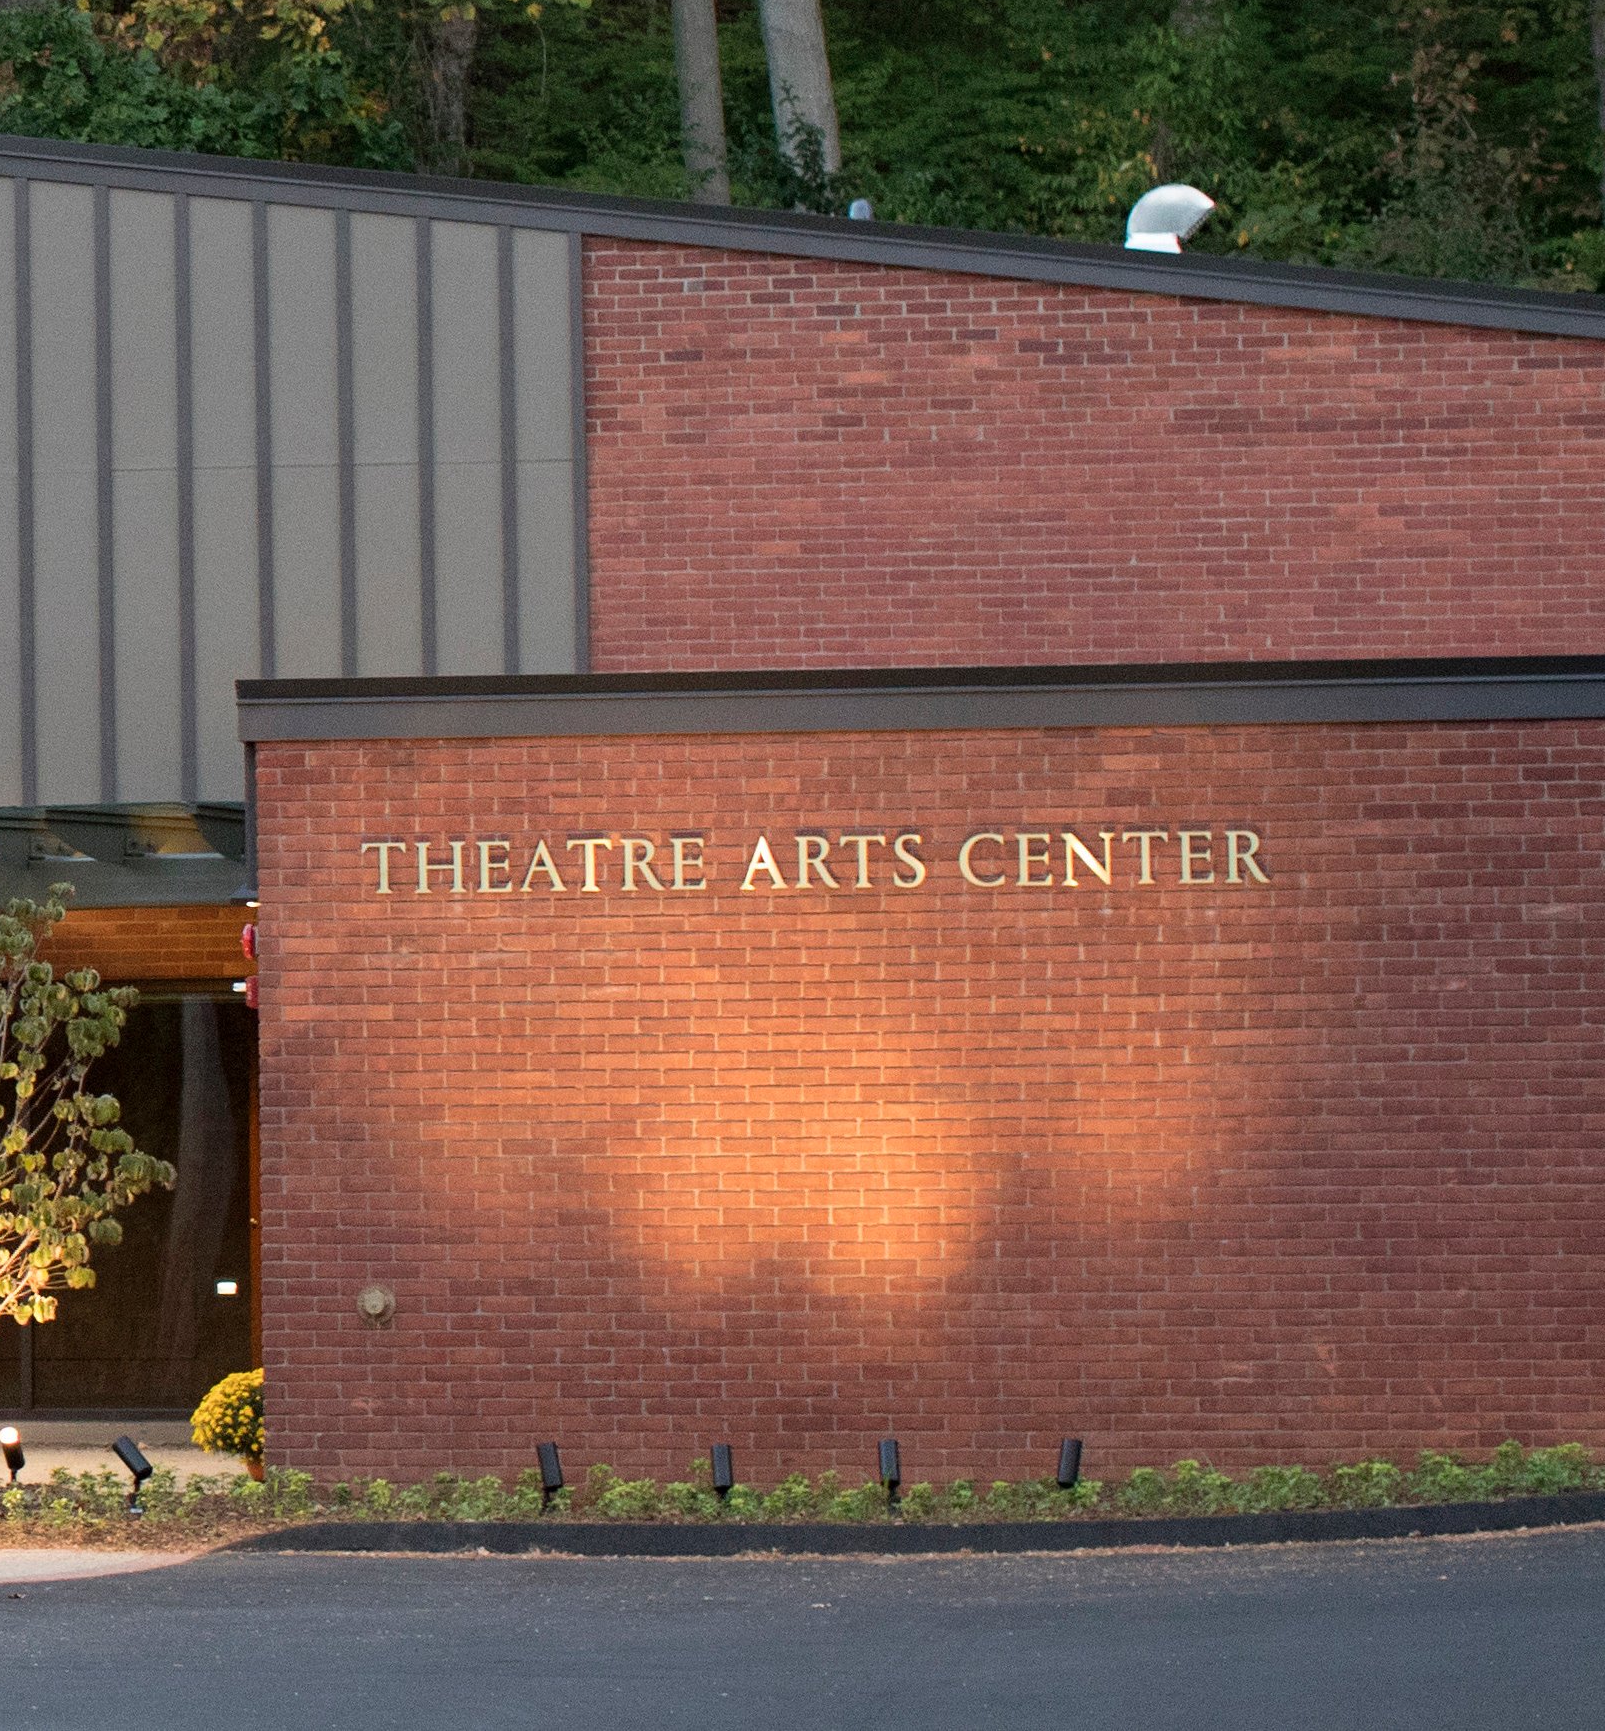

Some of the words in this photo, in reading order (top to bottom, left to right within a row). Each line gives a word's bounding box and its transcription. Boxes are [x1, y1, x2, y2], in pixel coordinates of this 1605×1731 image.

[361, 837, 707, 895] THEATRE
[738, 833, 927, 891] ARTS
[958, 830, 1271, 888] CENTER
